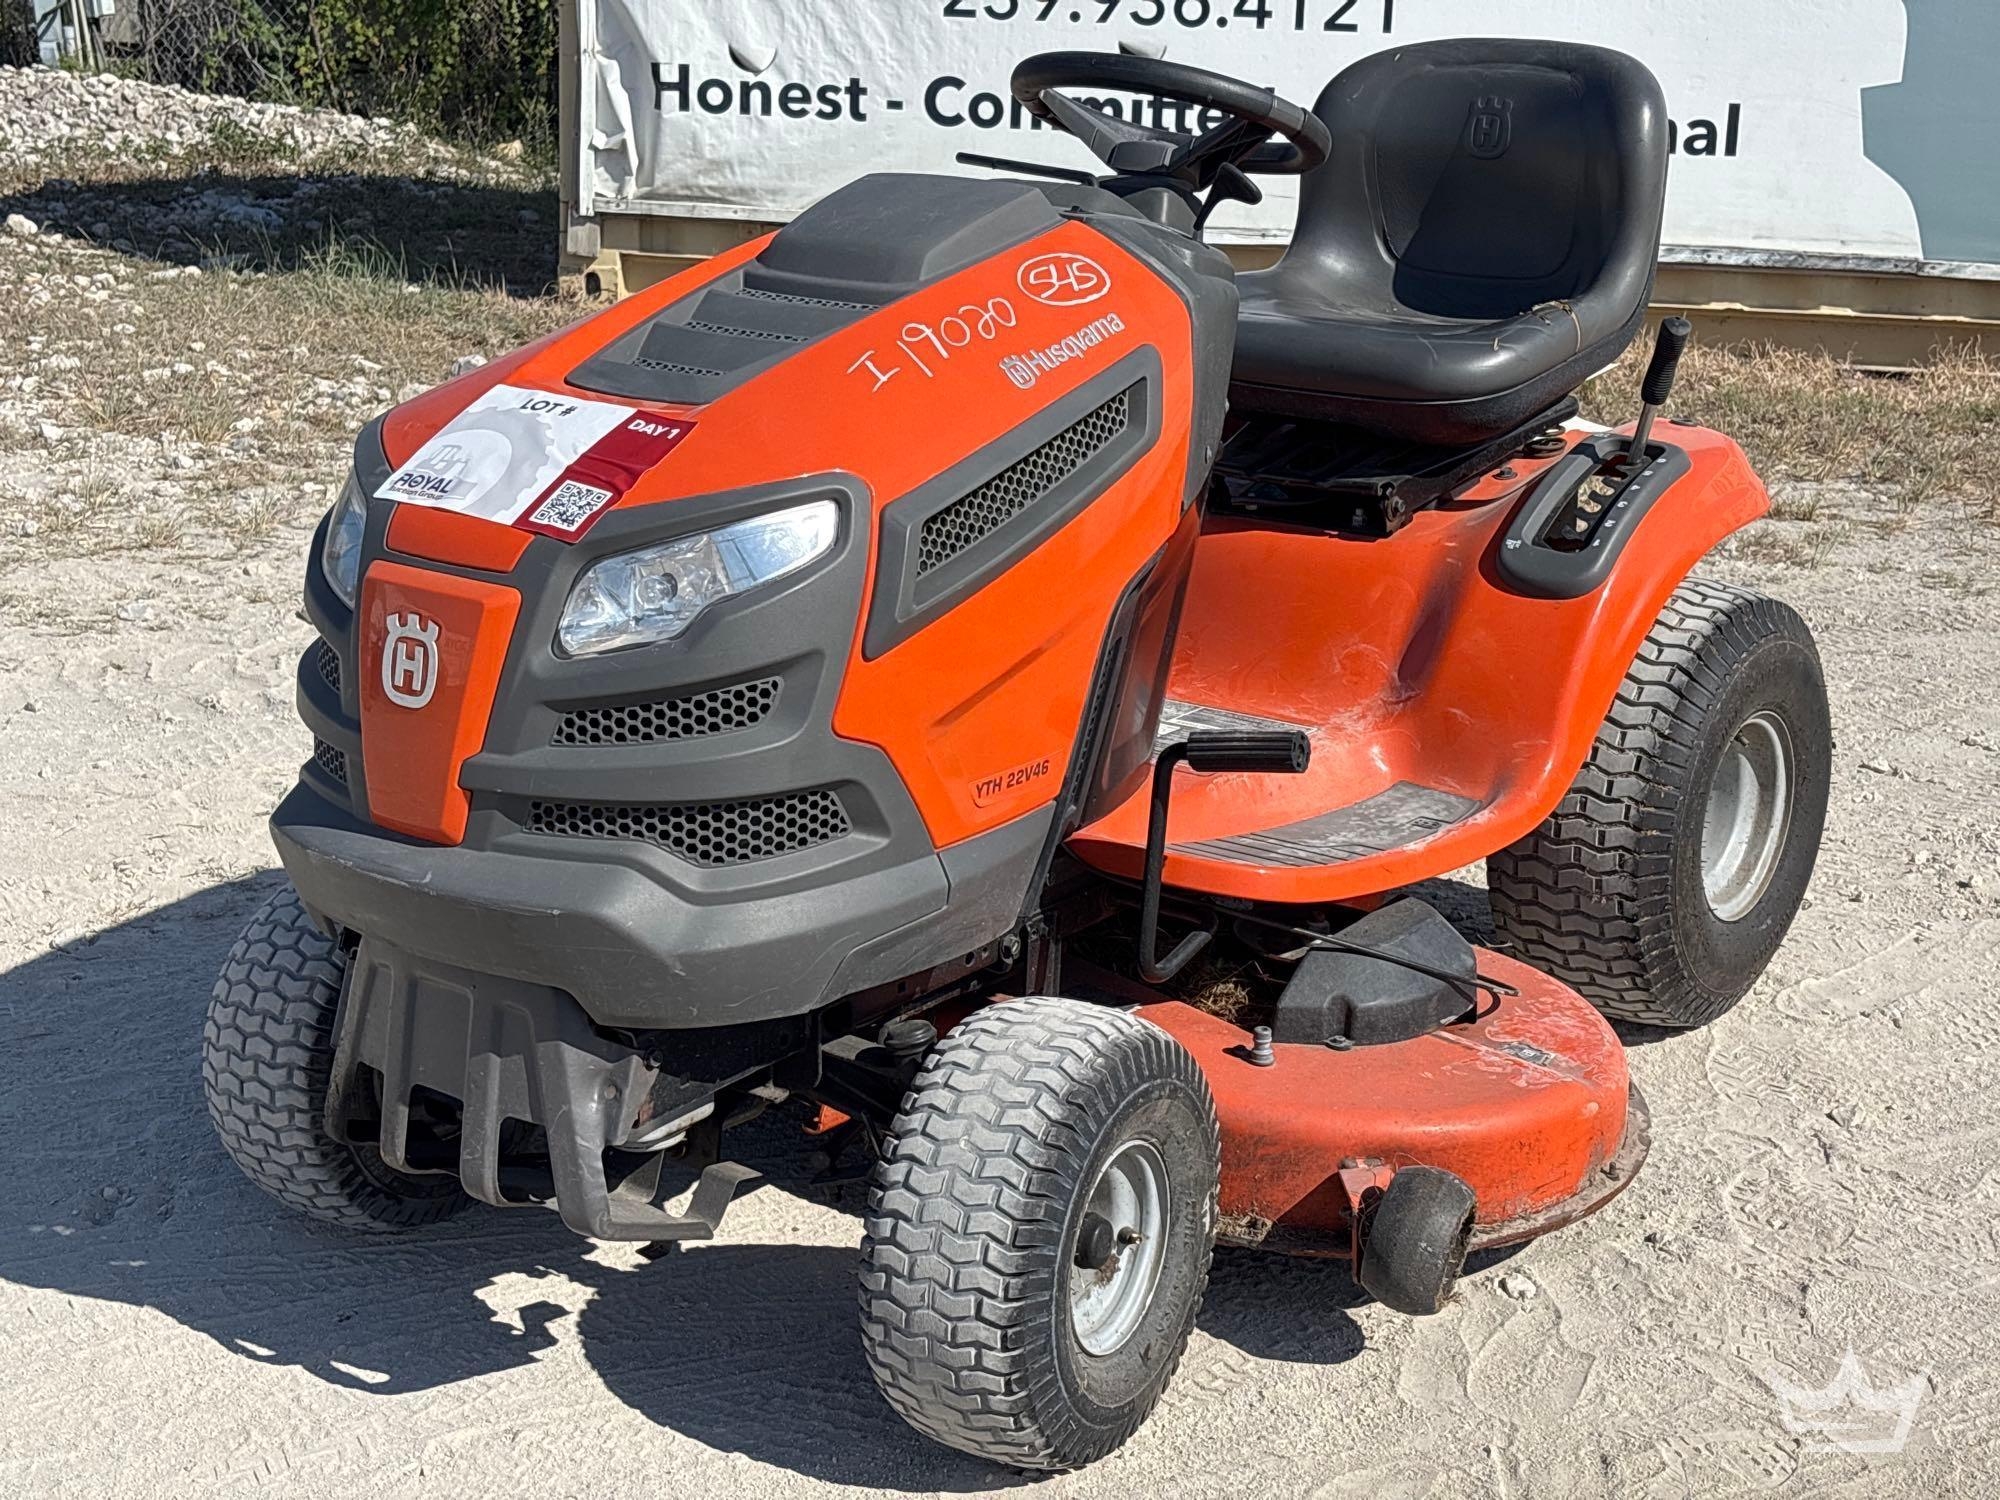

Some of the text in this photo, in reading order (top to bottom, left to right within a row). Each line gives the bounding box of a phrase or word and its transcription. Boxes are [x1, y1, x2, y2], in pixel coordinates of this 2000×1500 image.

[651, 62, 868, 122] Honest
[1021, 311, 1126, 377] Husqvarna
[520, 398, 579, 417] LOT #
[627, 419, 681, 440] DAY 1
[394, 472, 454, 494] ROYAL
[975, 759, 1050, 799] YTH 22V46
